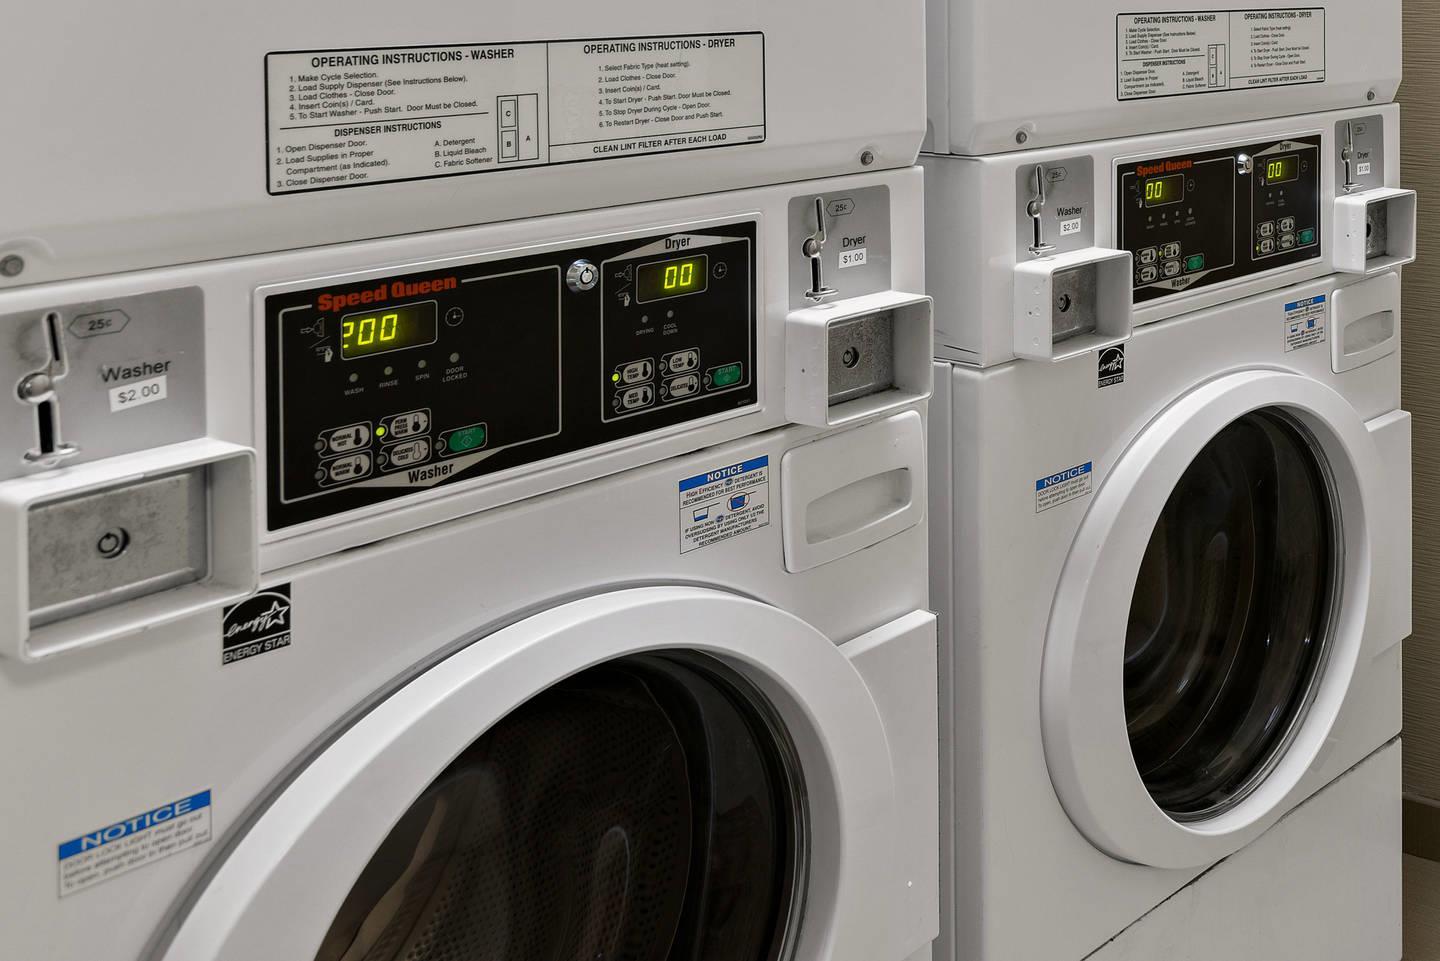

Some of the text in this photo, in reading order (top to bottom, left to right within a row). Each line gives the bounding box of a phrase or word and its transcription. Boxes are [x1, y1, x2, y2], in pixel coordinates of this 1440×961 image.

[583, 39, 735, 54] OPERATING INSTRUCTIONS DRYER
[312, 49, 514, 67] OPERATING INSTRUCTIONS WASHER
[320, 83, 344, 91] Supply
[347, 81, 383, 89] Dispenser
[403, 77, 441, 85] Instructions
[453, 100, 478, 108] Closed.
[628, 96, 643, 104] Dryer
[613, 104, 677, 116] Stop Dryer During Cycle
[334, 121, 441, 137] DISPENSER INSTRUCTIONS
[285, 145, 306, 153] Open
[309, 142, 345, 151] Dispenser
[443, 138, 475, 146] Detergent
[593, 133, 727, 153] CLEAN LINT FILTER AFTER EACH LOAD
[285, 150, 374, 164] Load Supplies Proper
[443, 149, 462, 157] Liquid
[444, 156, 492, 167] Fabric Softener
[286, 164, 337, 175] Compartment
[1136, 160, 1192, 177] Speed Queen
[1268, 162, 1281, 178] 00
[286, 179, 307, 187] Close
[310, 175, 346, 185] Dispenser
[1146, 181, 1162, 199] 00
[1057, 207, 1082, 216] Washer
[1064, 222, 1078, 231] $2.00
[665, 238, 690, 250] Dryer
[843, 236, 866, 247] Dryer
[843, 253, 863, 263] $1.00
[664, 263, 693, 289] 00
[318, 276, 457, 312] Speed Queen
[636, 327, 654, 335] DRYING
[101, 360, 171, 383] Washer
[446, 366, 464, 375] DOOR
[718, 366, 736, 374] START
[415, 373, 430, 381] SPIN
[442, 373, 468, 382] LOCKED
[379, 380, 398, 388] RINSE
[118, 383, 160, 404] $2.00
[344, 387, 364, 395] WASH
[408, 463, 454, 483] Washer
[707, 465, 743, 482] NOTICE
[735, 473, 757, 483] DETERGENT
[1044, 465, 1085, 487] NOTICE
[683, 493, 715, 506] RECOMMENDED
[736, 476, 766, 489] PERFORMANCE
[752, 504, 765, 512] AVOID
[724, 519, 738, 527] USING
[738, 515, 748, 523] ONLY
[693, 532, 720, 543] DETERGENT
[224, 635, 290, 663] ENERGY STAR
[81, 798, 192, 850] NOTICE
